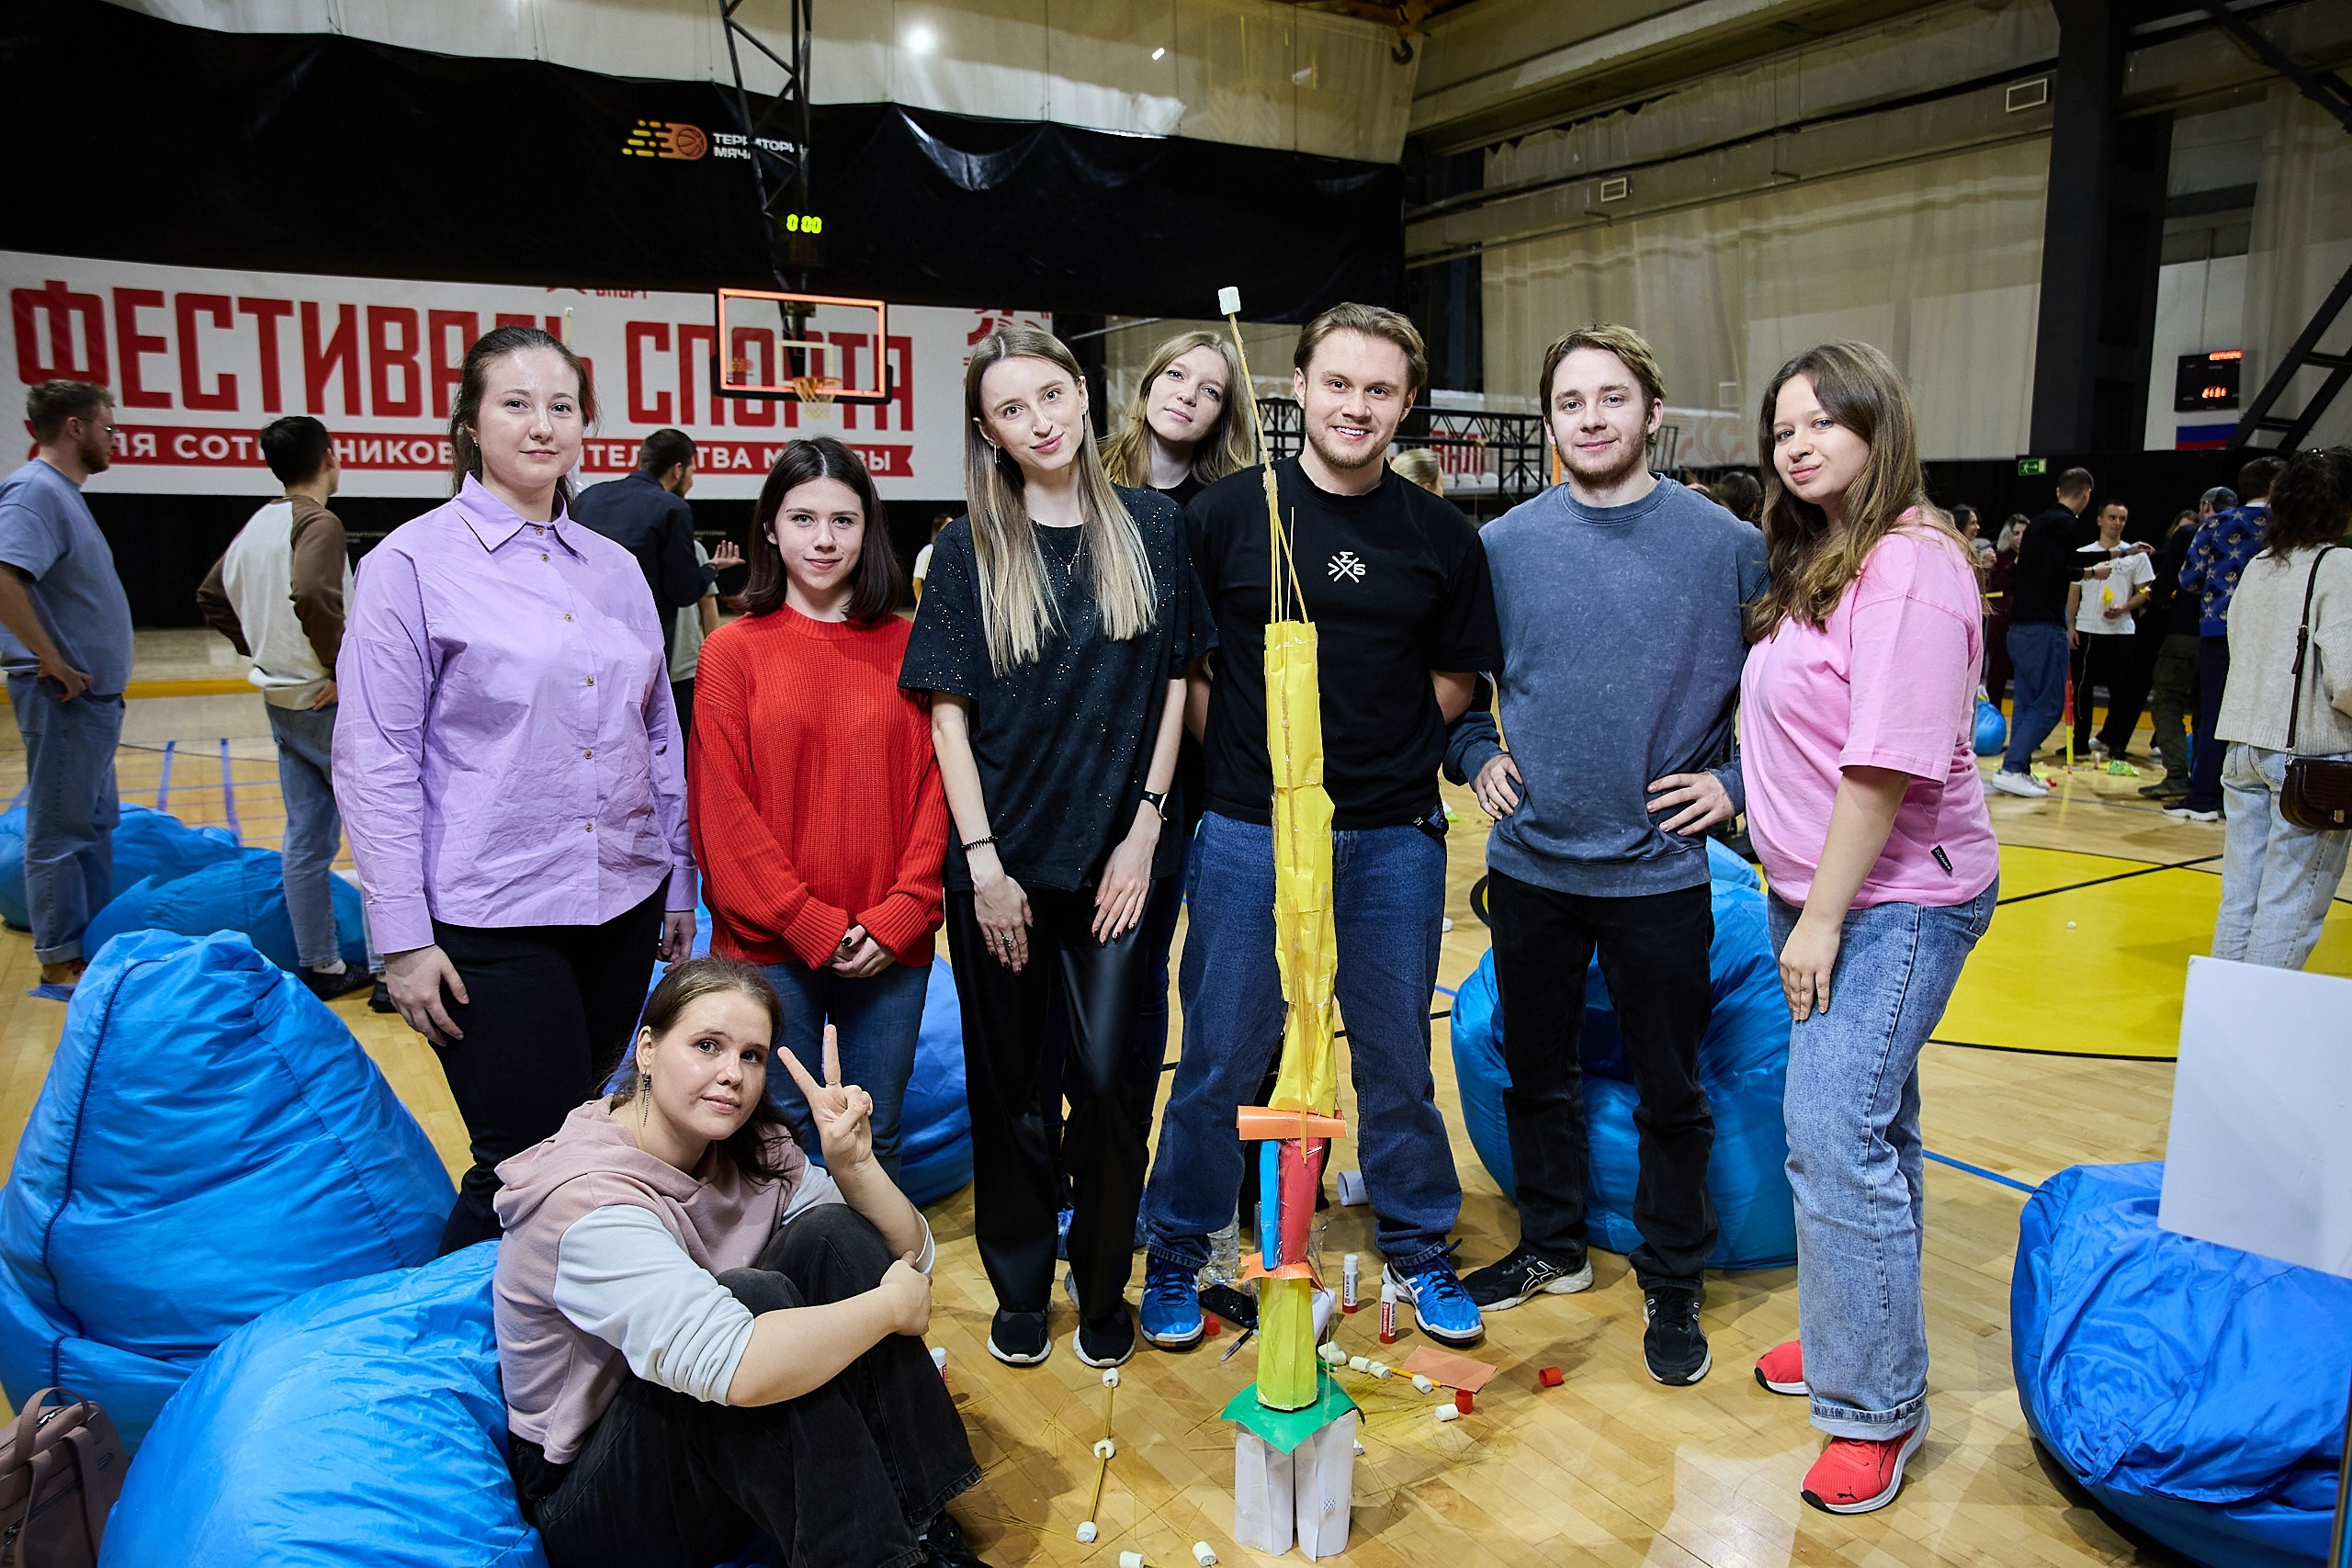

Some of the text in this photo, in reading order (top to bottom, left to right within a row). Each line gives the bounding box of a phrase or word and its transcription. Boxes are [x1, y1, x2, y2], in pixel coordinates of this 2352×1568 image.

[712, 132, 805, 153] ТЕРТОР
[11, 280, 914, 432] ФЕСТИВА СПОРТА
[174, 434, 453, 465] СОТНИКОВ
